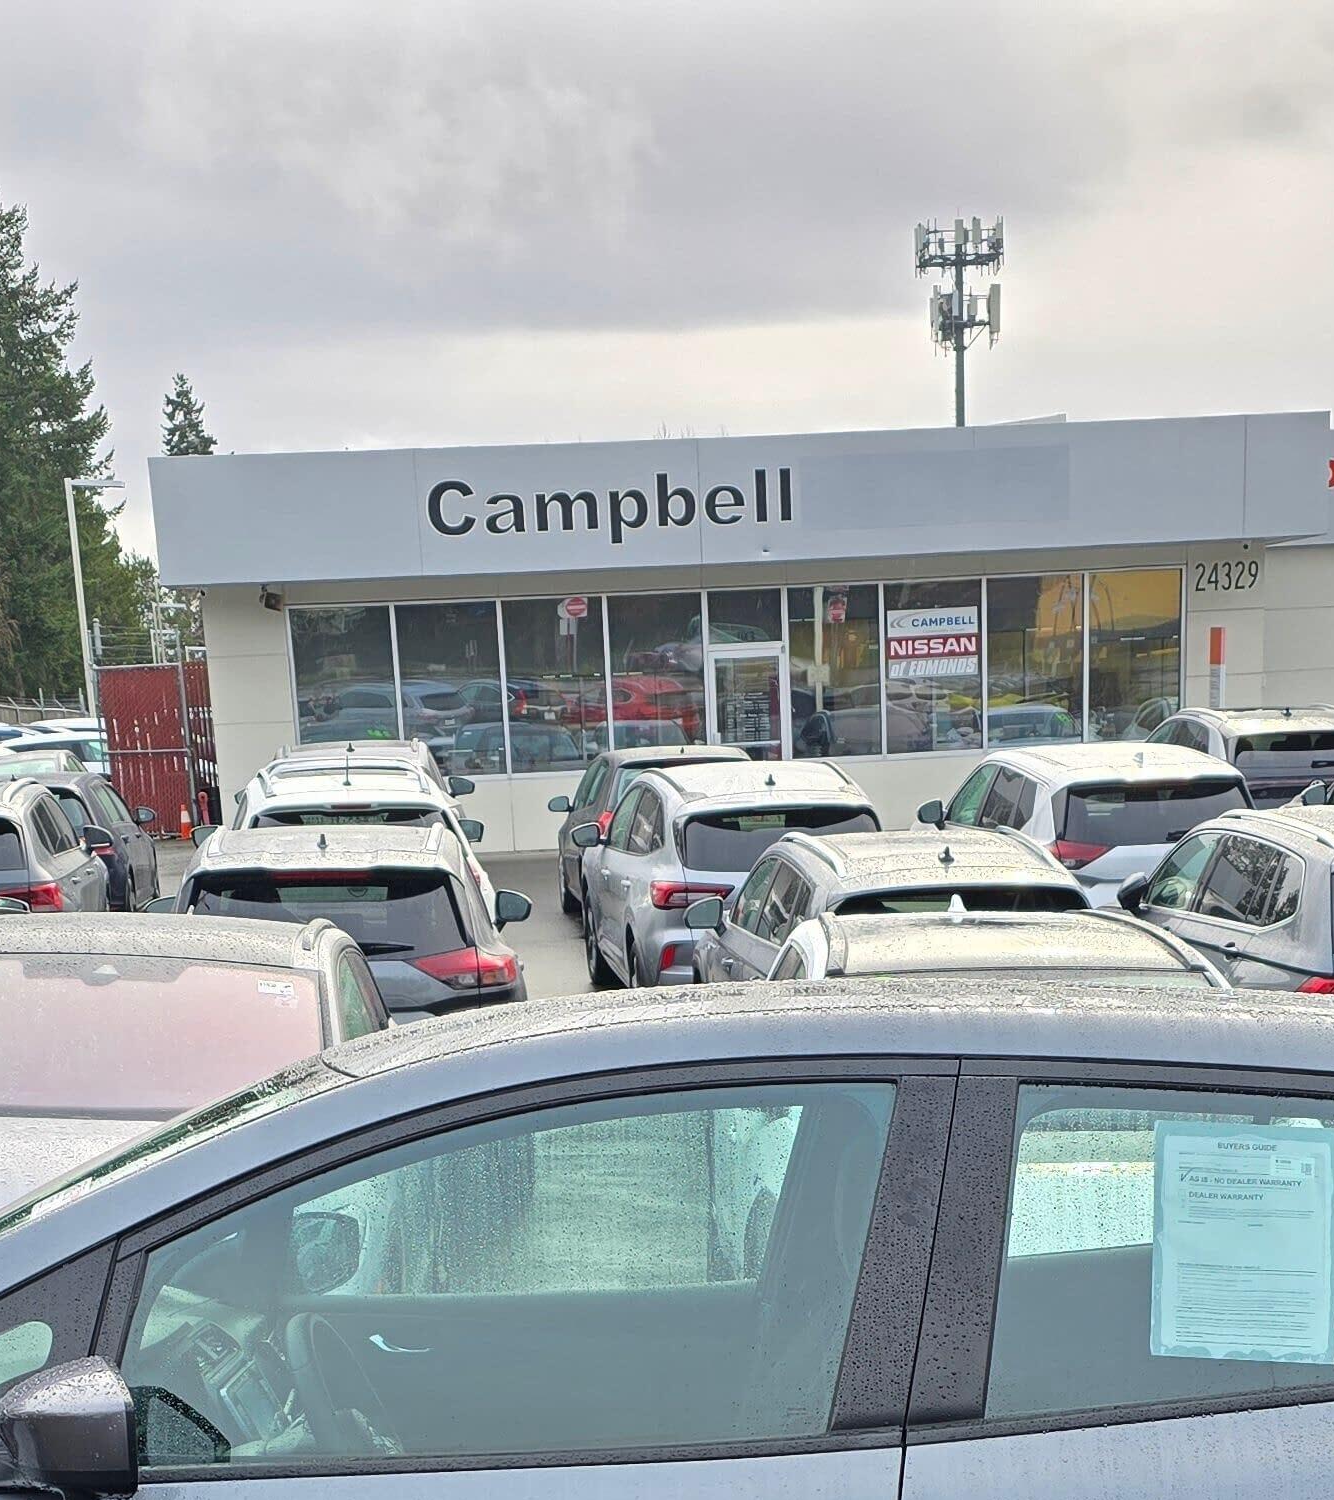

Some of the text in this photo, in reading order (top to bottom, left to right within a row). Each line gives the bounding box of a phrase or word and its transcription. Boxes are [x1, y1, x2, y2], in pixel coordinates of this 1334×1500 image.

[426, 467, 793, 544] Campbell
[1194, 560, 1259, 592] 24329
[911, 615, 975, 628] CAMPBELL
[889, 636, 977, 657] NISSAN
[890, 657, 978, 677] of EDMONDS
[1217, 1141, 1278, 1152] BUYERS GUIDE
[1214, 1177, 1225, 1185] NO
[1226, 1177, 1259, 1186] DEALER
[1259, 1178, 1302, 1188] WARRANTY
[1188, 1190, 1265, 1201] DEALER WARRANTY
